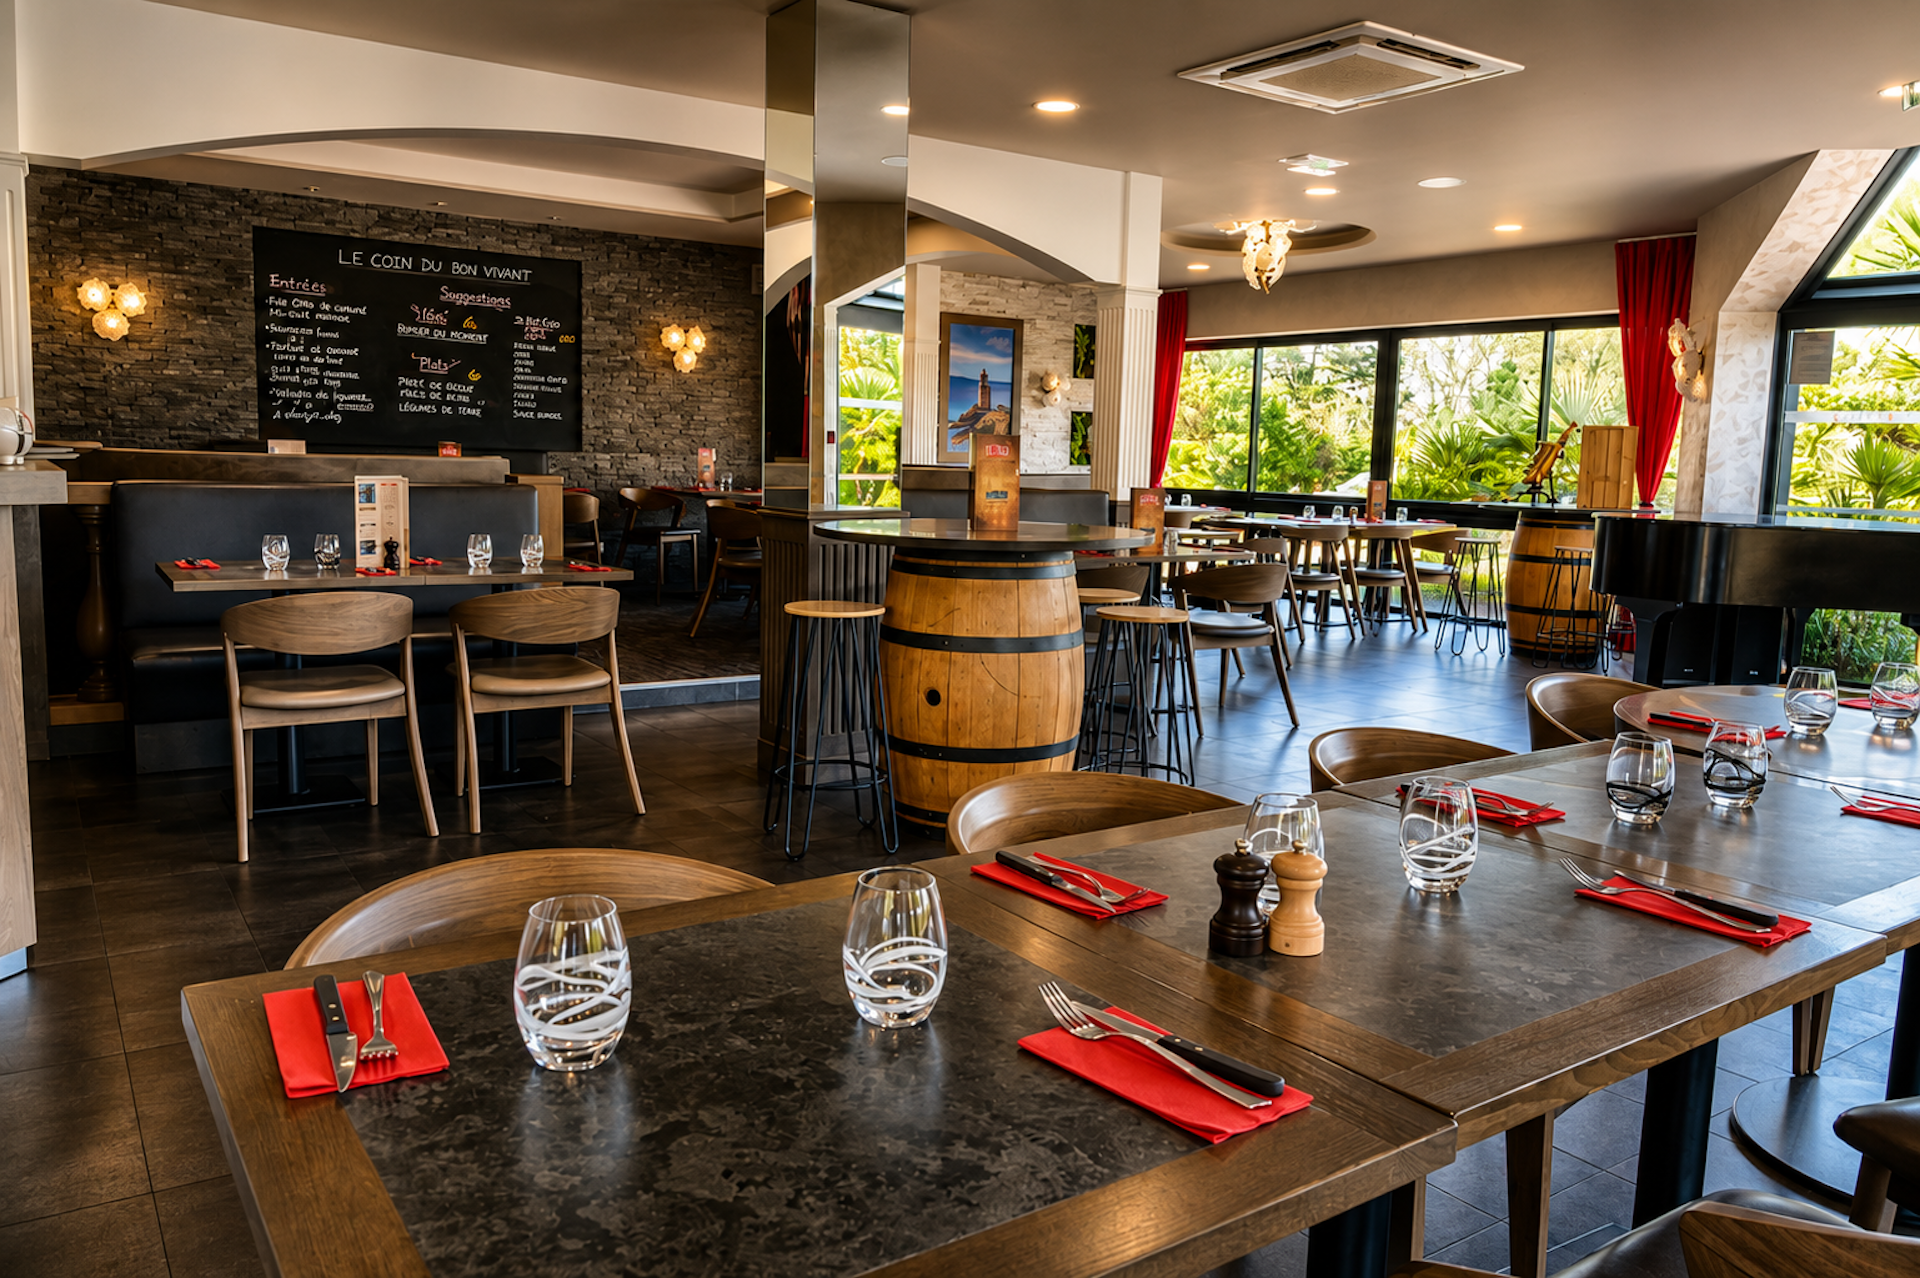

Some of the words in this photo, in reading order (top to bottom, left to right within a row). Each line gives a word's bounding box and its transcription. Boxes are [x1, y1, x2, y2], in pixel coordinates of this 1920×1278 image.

[338, 249, 364, 266] LE
[370, 253, 413, 270] COIN
[421, 257, 443, 273] DU
[451, 261, 478, 276] BON
[483, 265, 533, 282] VIVANT
[268, 273, 328, 293] Entrées
